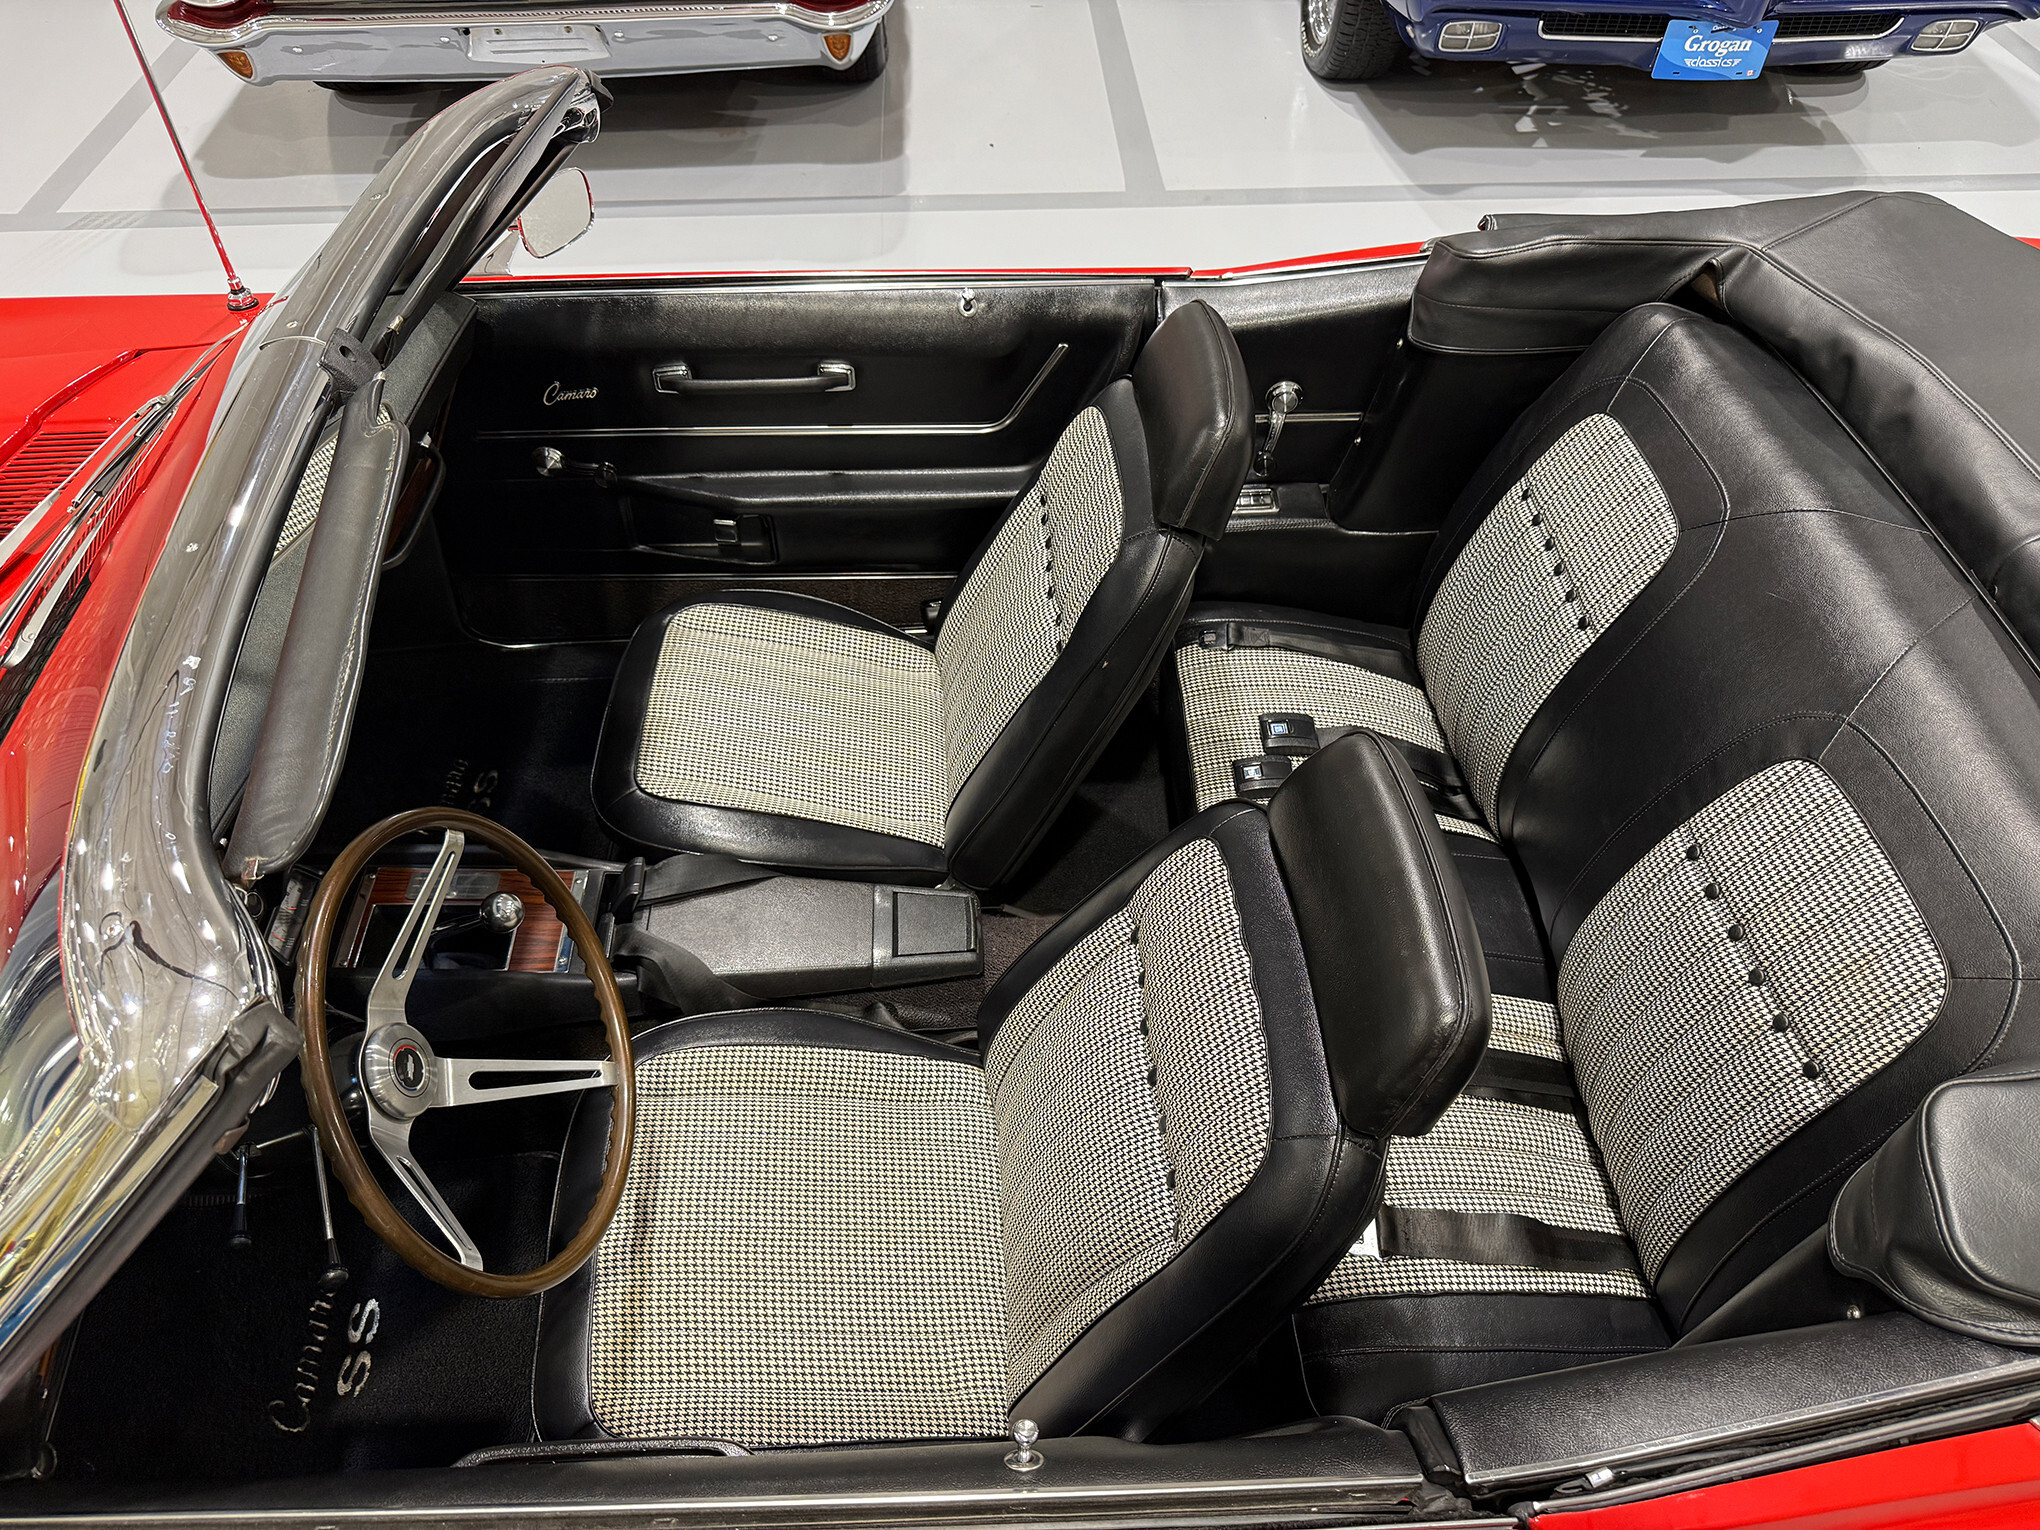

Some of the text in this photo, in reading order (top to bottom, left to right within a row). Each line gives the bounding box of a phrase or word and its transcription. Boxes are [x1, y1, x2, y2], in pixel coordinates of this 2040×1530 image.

[1684, 35, 1752, 57] Grogan
[542, 381, 599, 406] Camaro
[268, 1288, 337, 1433] Camar
[337, 1298, 380, 1398] SS
